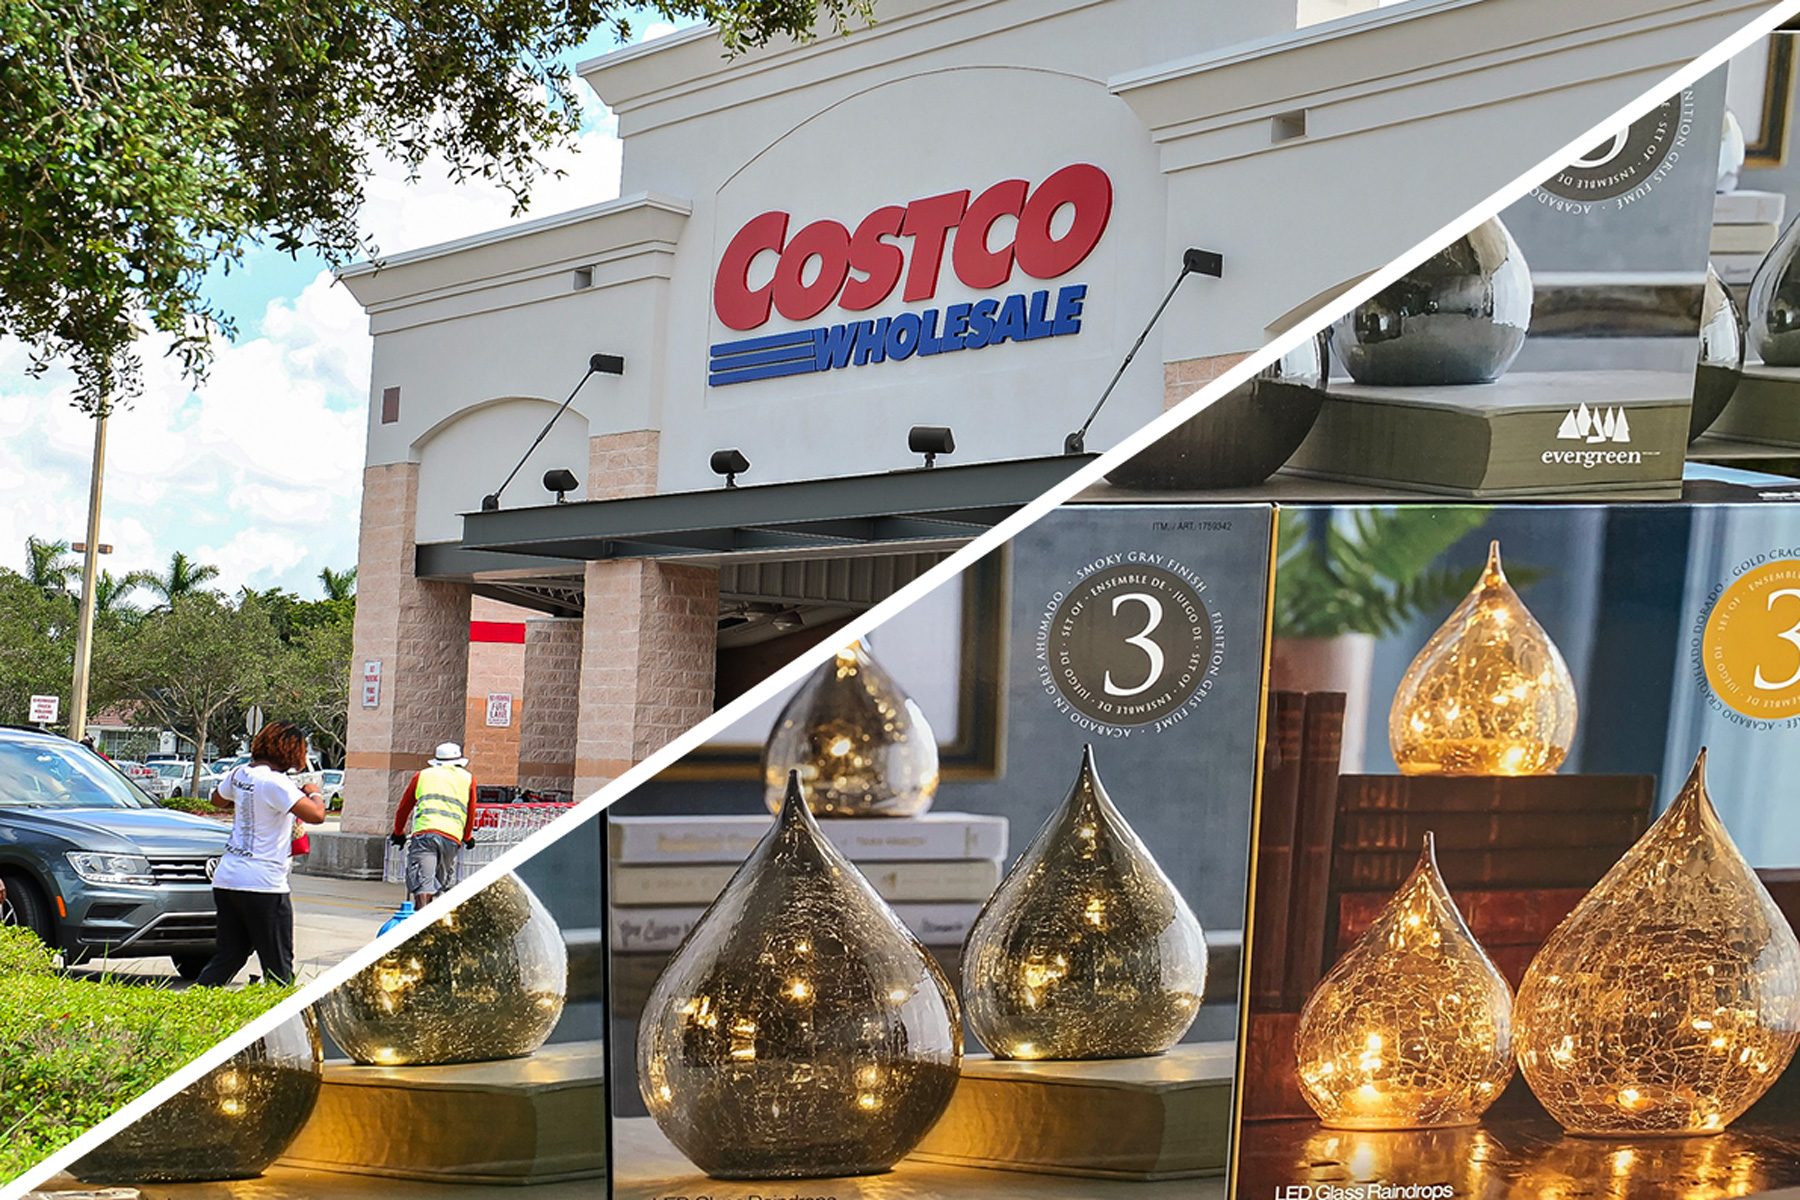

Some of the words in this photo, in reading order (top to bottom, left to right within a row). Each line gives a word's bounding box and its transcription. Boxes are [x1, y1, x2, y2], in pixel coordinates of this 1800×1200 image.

[1654, 121, 1668, 143] SET
[1677, 90, 1694, 148] NITION
[1643, 144, 1657, 161] OF
[1557, 173, 1573, 186] DE
[1576, 166, 1636, 189] ENSEMBLE
[1653, 151, 1679, 184] GRIS
[1528, 187, 1592, 215] ACABADO
[713, 163, 1113, 330] COSTCO
[815, 284, 1088, 372] WHOLESALE
[1541, 450, 1642, 468] evergreen
[1076, 552, 1123, 580] SMOKY
[1127, 551, 1165, 564] GRAY
[1167, 558, 1207, 593] FINISH
[1732, 552, 1766, 577] GOLD
[1090, 574, 1149, 597] ENSEMBLE
[1151, 577, 1167, 591] DE
[1061, 618, 1074, 637] SET
[1070, 601, 1084, 616] OF
[1172, 590, 1199, 624] JUEGO
[1191, 626, 1202, 641] DE
[1692, 582, 1724, 634] DORADO
[1717, 613, 1731, 632] SET
[1727, 596, 1741, 611] OF
[1035, 591, 1064, 660] AHUMADO
[1753, 588, 1800, 690] 3
[1104, 592, 1164, 696] 3
[1211, 611, 1225, 676] FINITION
[1714, 646, 1723, 660] DE
[1060, 651, 1070, 665] DE
[1188, 652, 1201, 672] SET
[1037, 665, 1056, 695] GRIS
[1064, 668, 1091, 700] JUEGO
[1178, 673, 1191, 688] OF
[1690, 637, 1723, 711] CRAQUELADO
[1716, 663, 1740, 694] JUEGO
[1053, 697, 1070, 714] EN
[1097, 701, 1113, 713] DE
[1116, 693, 1172, 715] ENSEMBLE
[1188, 679, 1213, 708] GRIS
[1745, 695, 1760, 706] DE
[1070, 712, 1132, 738] ACABADO
[1722, 708, 1775, 731] ACABADO
[1275, 1185, 1313, 1200] LED
[1315, 1184, 1365, 1200] Glass
[1367, 1182, 1454, 1200] Raindrops
